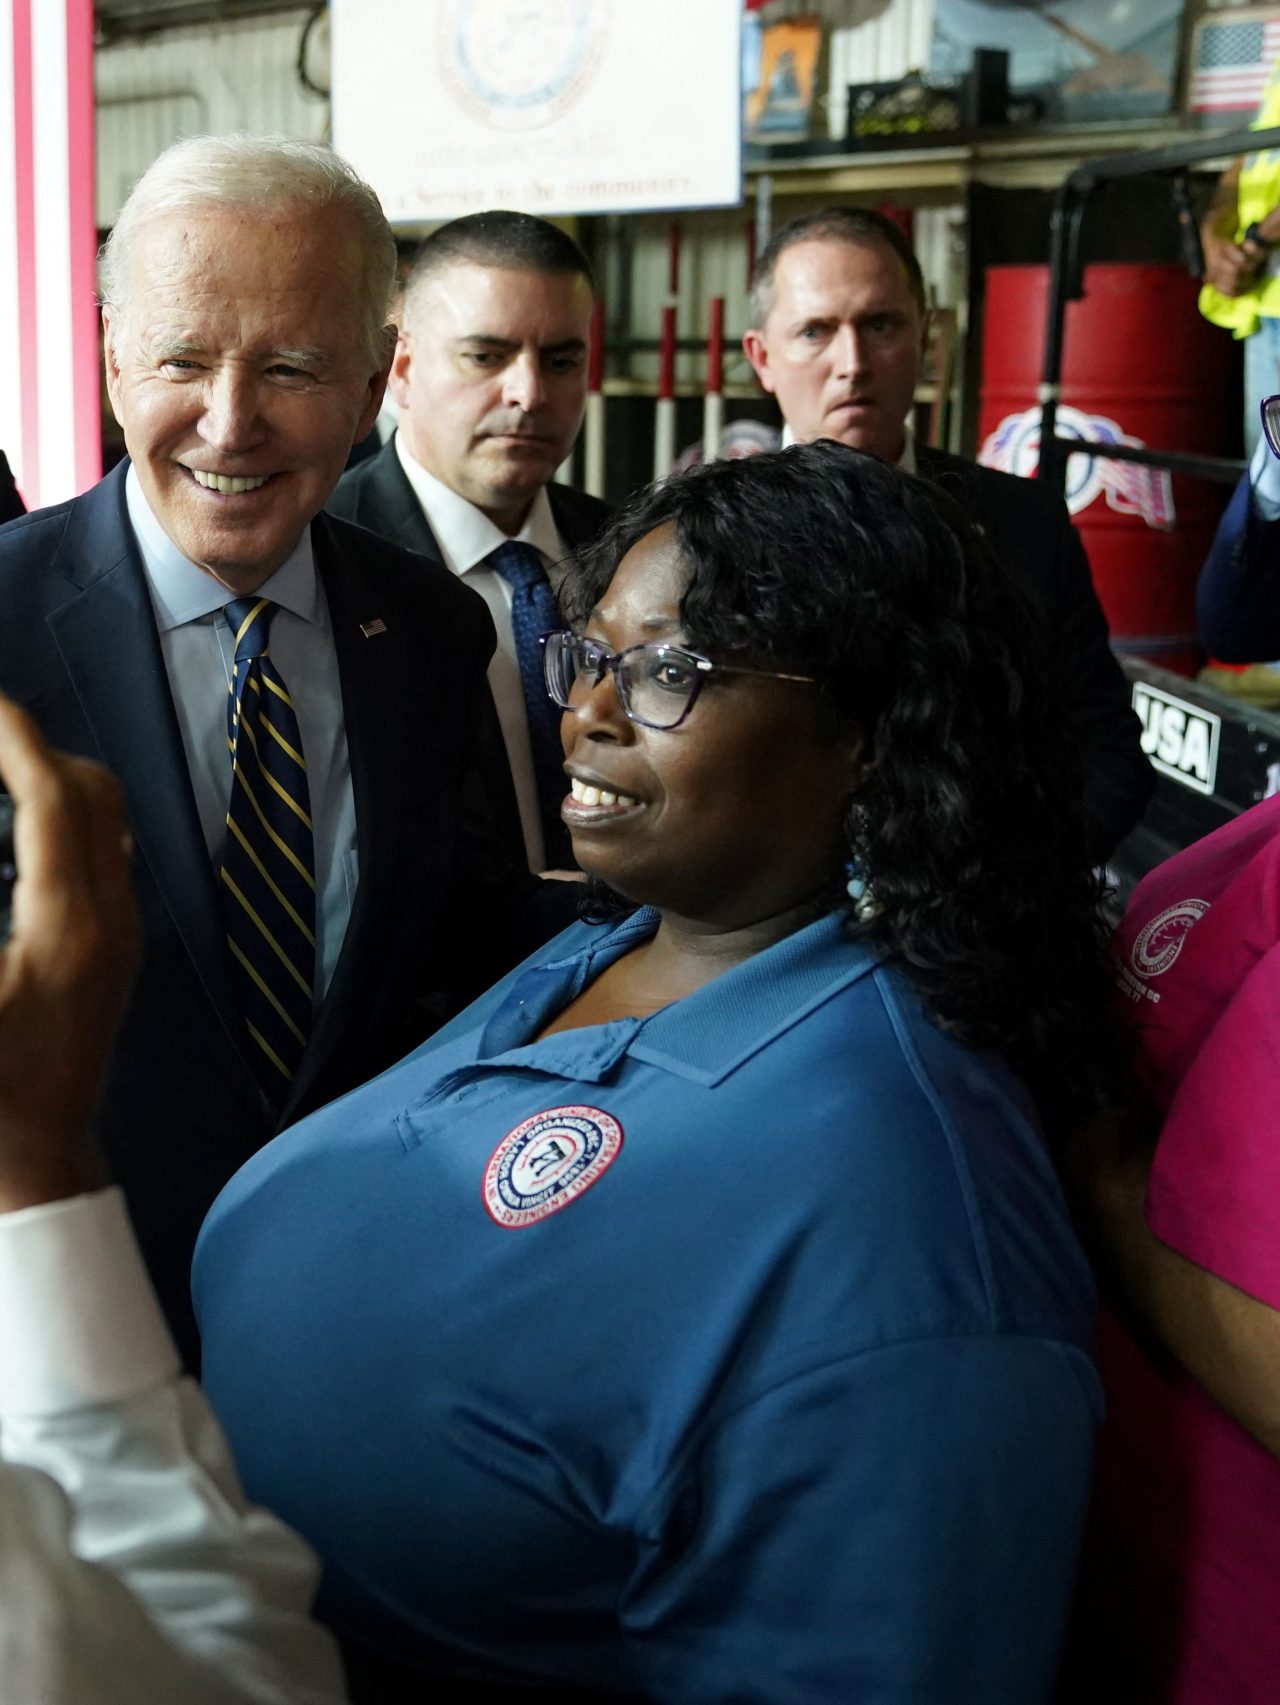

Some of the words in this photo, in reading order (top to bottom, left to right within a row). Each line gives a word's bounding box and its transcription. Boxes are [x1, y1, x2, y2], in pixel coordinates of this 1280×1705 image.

[1135, 693, 1210, 780] USA
[486, 1111, 553, 1199] INTERNATIONAL
[573, 1130, 619, 1193] OPERATING
[498, 1139, 525, 1180] LABOR
[526, 1117, 594, 1140] ORGANIZED
